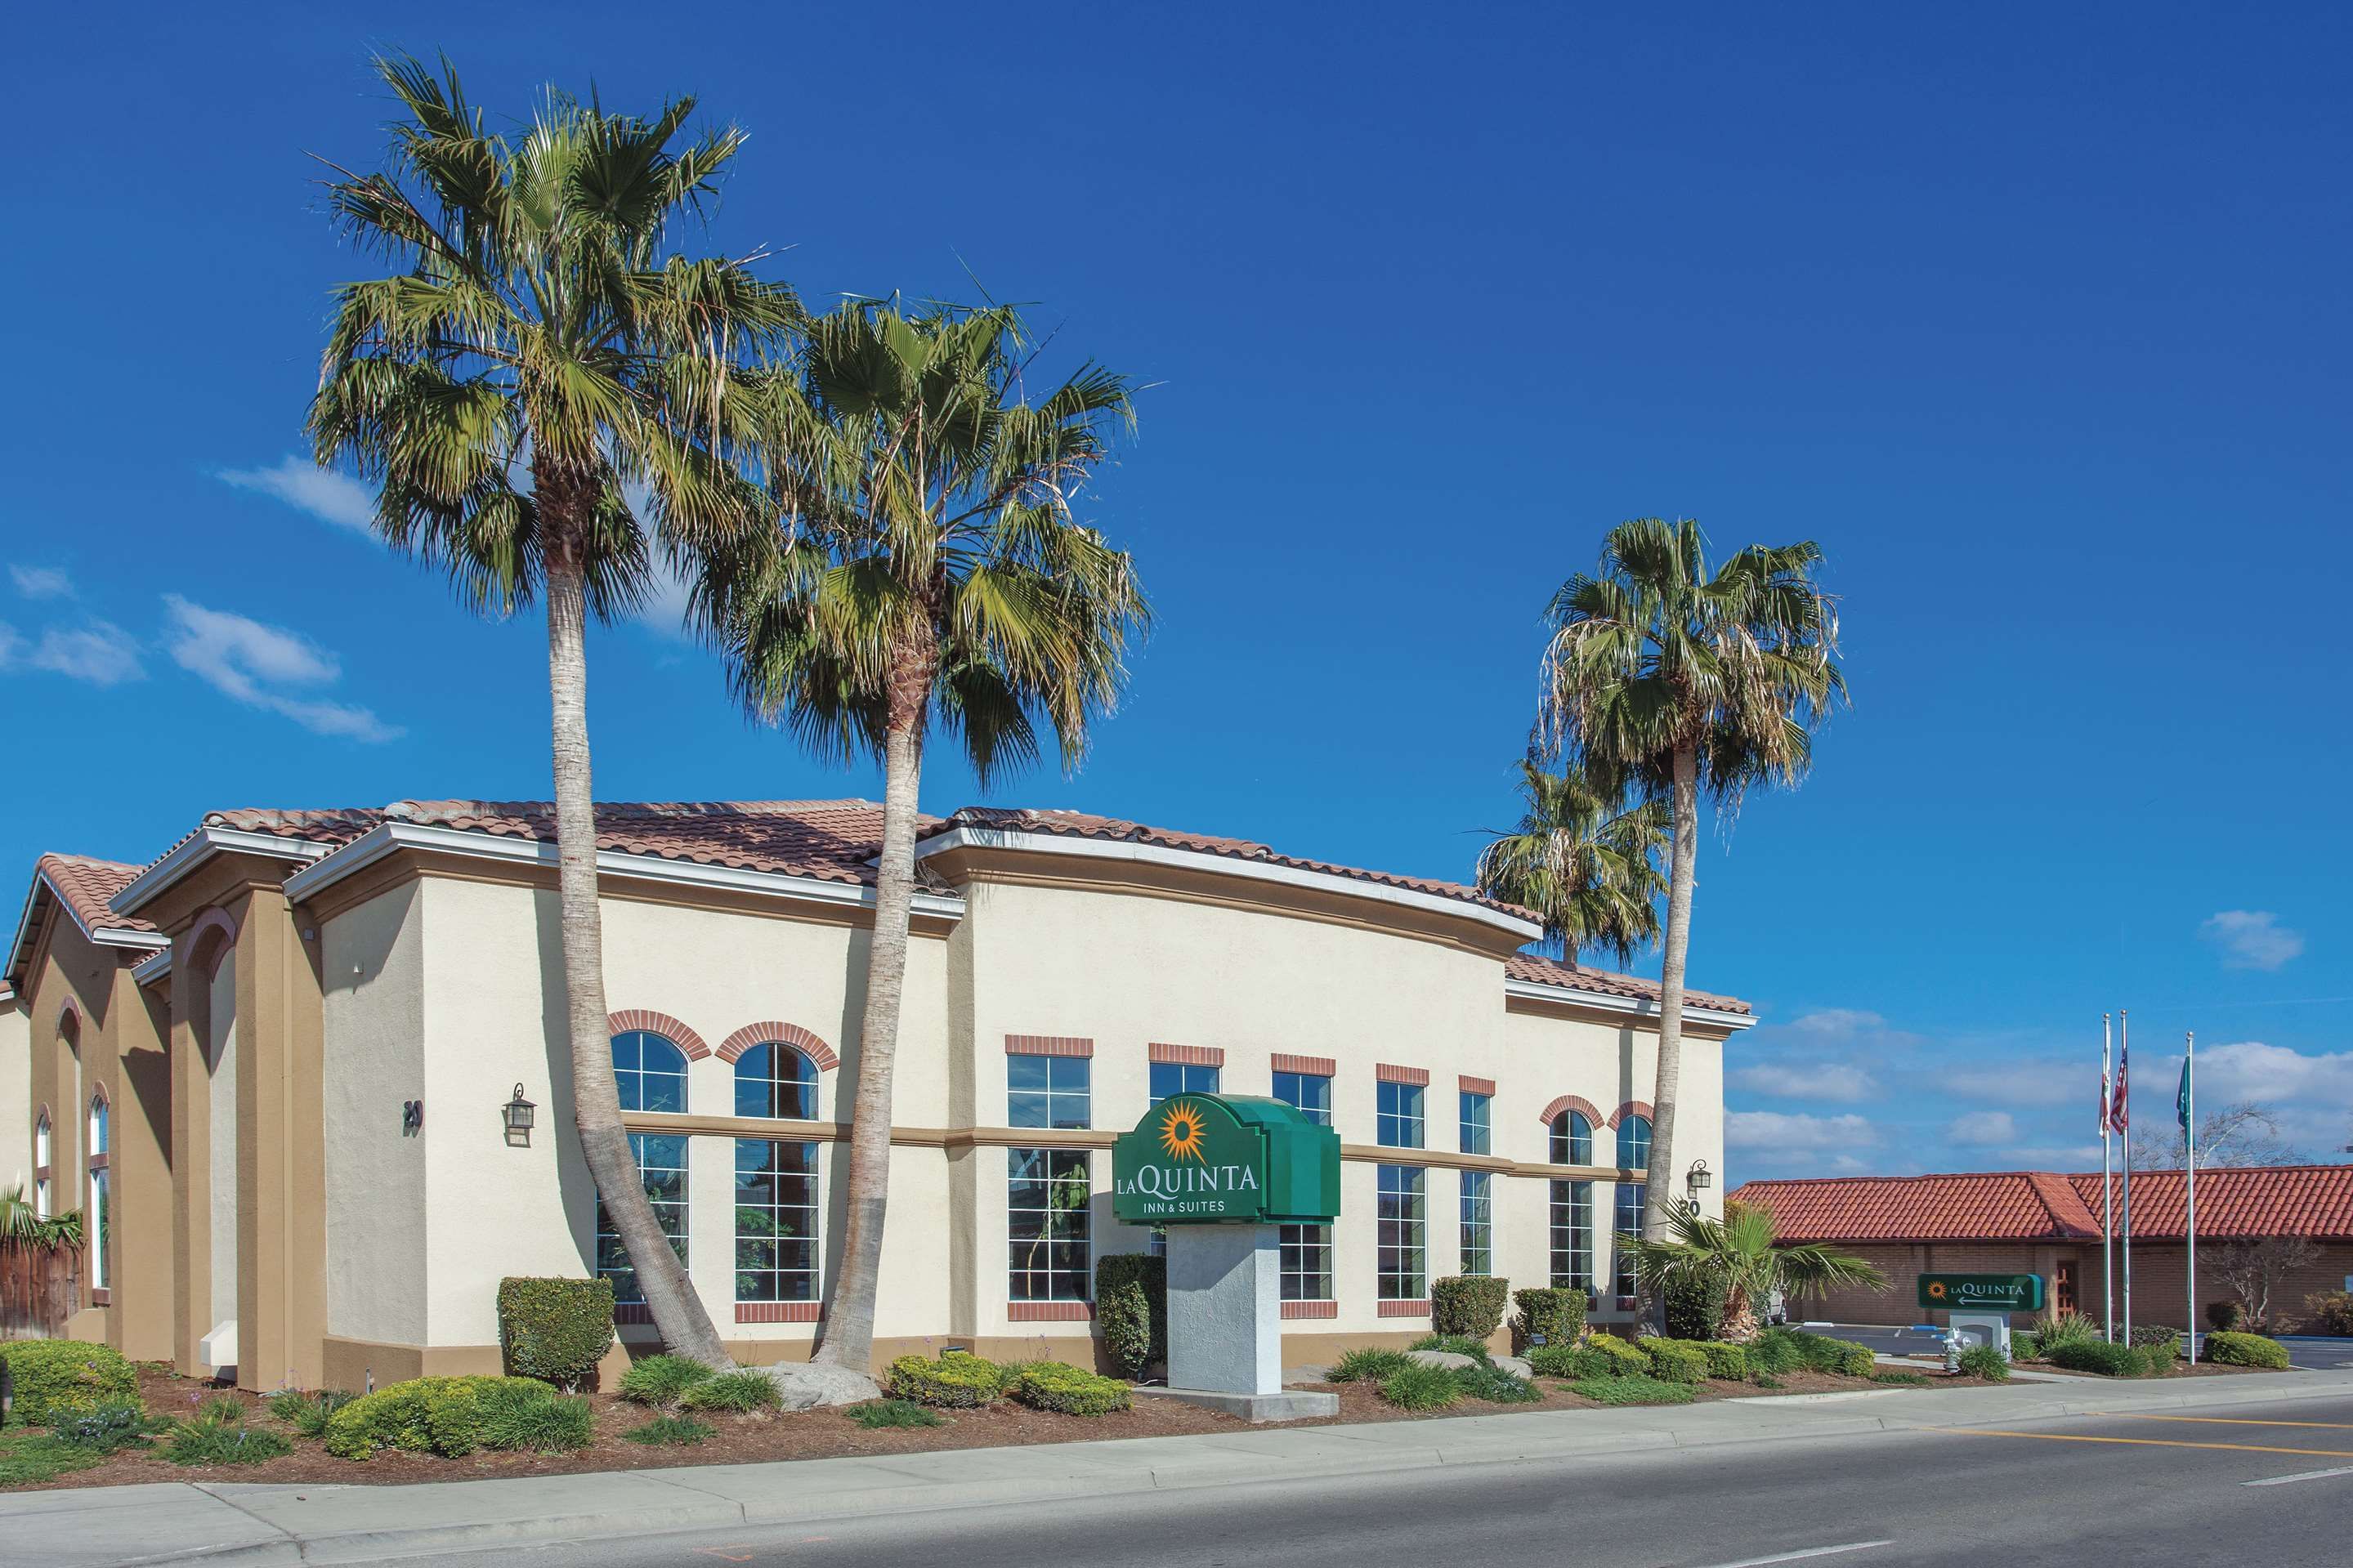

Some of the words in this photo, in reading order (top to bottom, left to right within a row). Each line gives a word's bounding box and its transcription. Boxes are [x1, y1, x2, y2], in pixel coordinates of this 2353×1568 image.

[1117, 1179, 1137, 1195] LA
[1138, 1164, 1258, 1200] QUINTA
[1143, 1202, 1165, 1213] INN
[1168, 1204, 1175, 1213] &
[1179, 1200, 1225, 1213] SUITES
[1962, 1283, 2025, 1297] QUINTA
